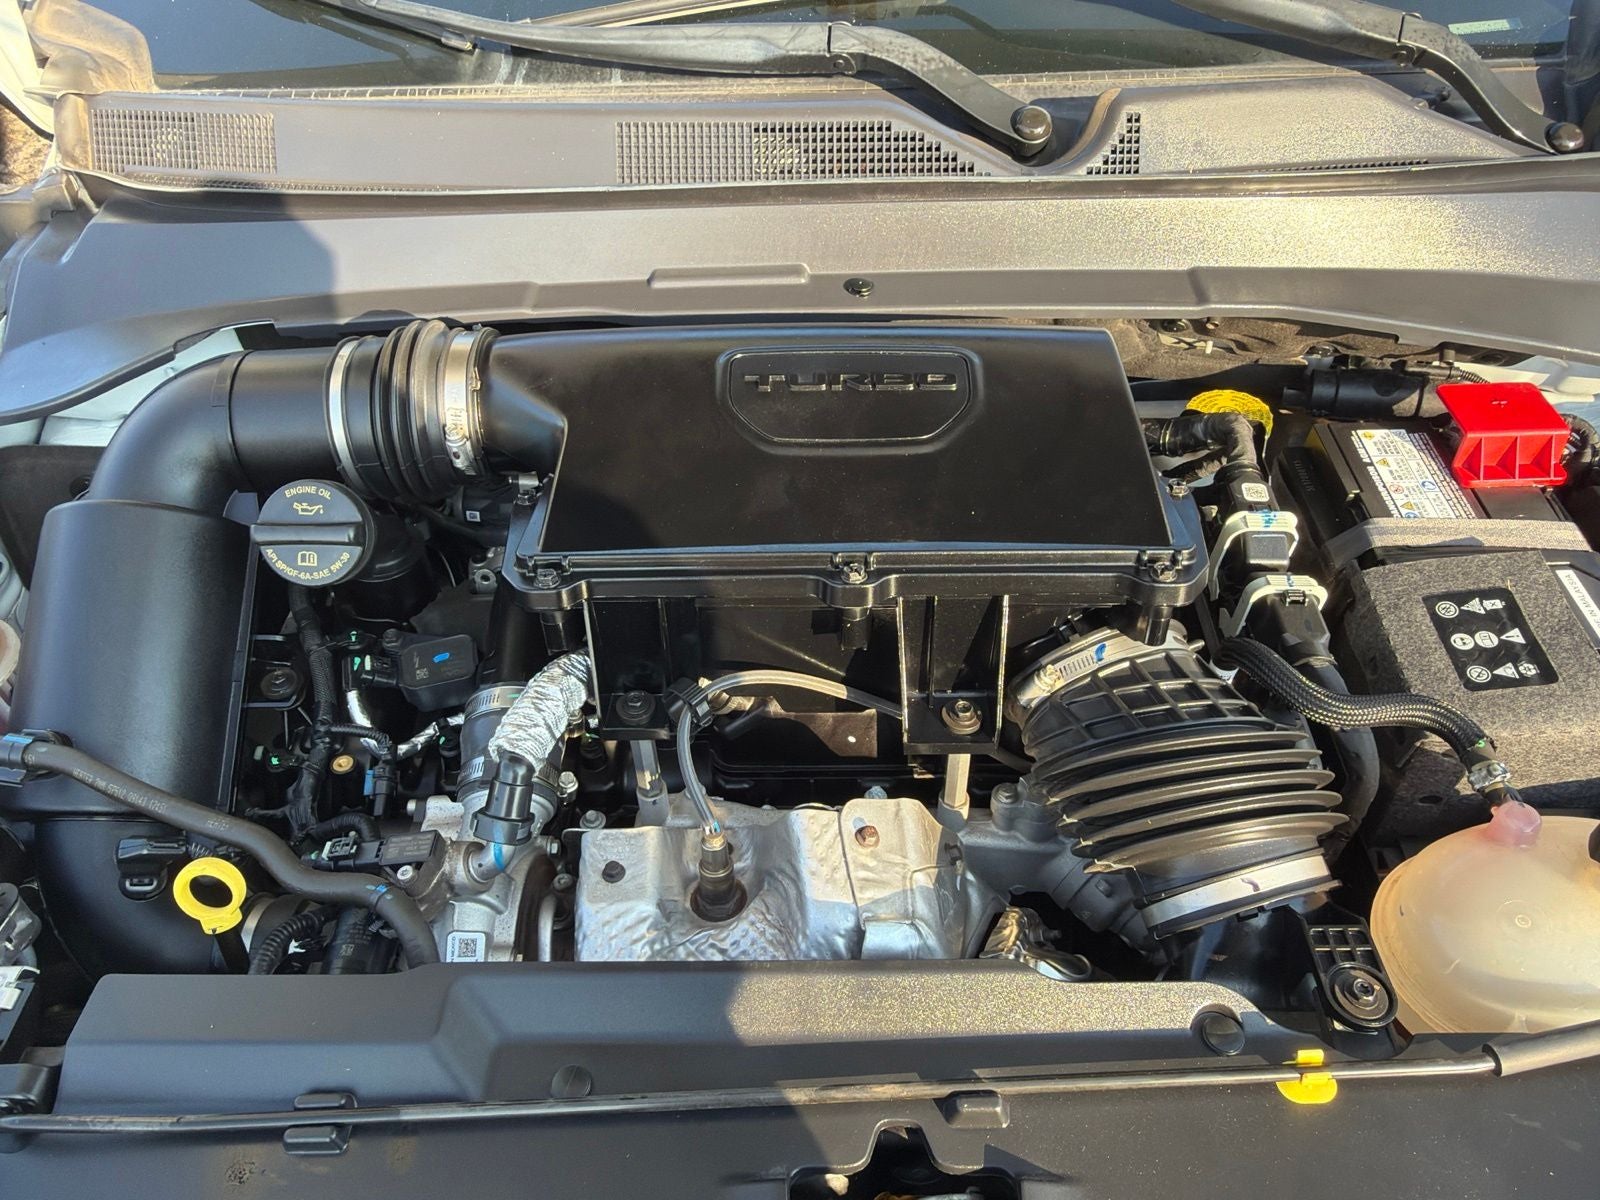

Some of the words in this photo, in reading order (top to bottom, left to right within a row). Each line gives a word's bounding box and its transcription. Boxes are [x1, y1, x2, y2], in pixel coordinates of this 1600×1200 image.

[744, 373, 957, 392] TURBO
[284, 485, 317, 498] ENGINE
[318, 488, 331, 500] OIL
[265, 548, 277, 563] API
[330, 552, 351, 573] 5W-30
[1565, 574, 1592, 608] MALAYSIA
